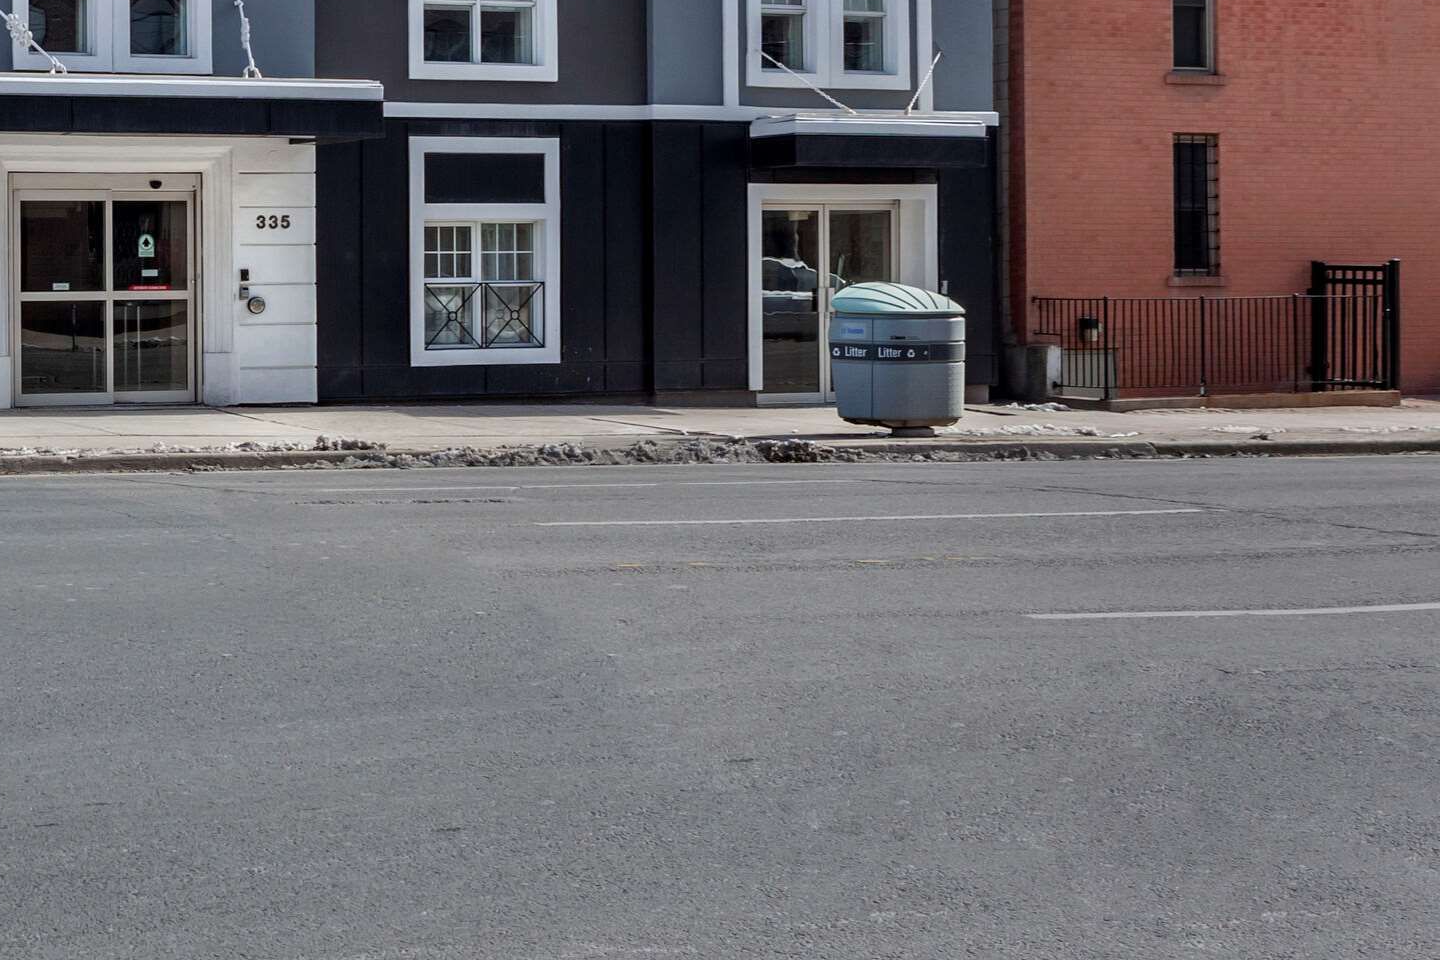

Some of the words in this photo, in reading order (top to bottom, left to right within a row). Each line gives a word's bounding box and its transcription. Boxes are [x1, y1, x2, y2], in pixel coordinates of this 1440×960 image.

[256, 215, 291, 229] 335
[844, 346, 867, 357] Litter
[878, 347, 901, 358] Litter
